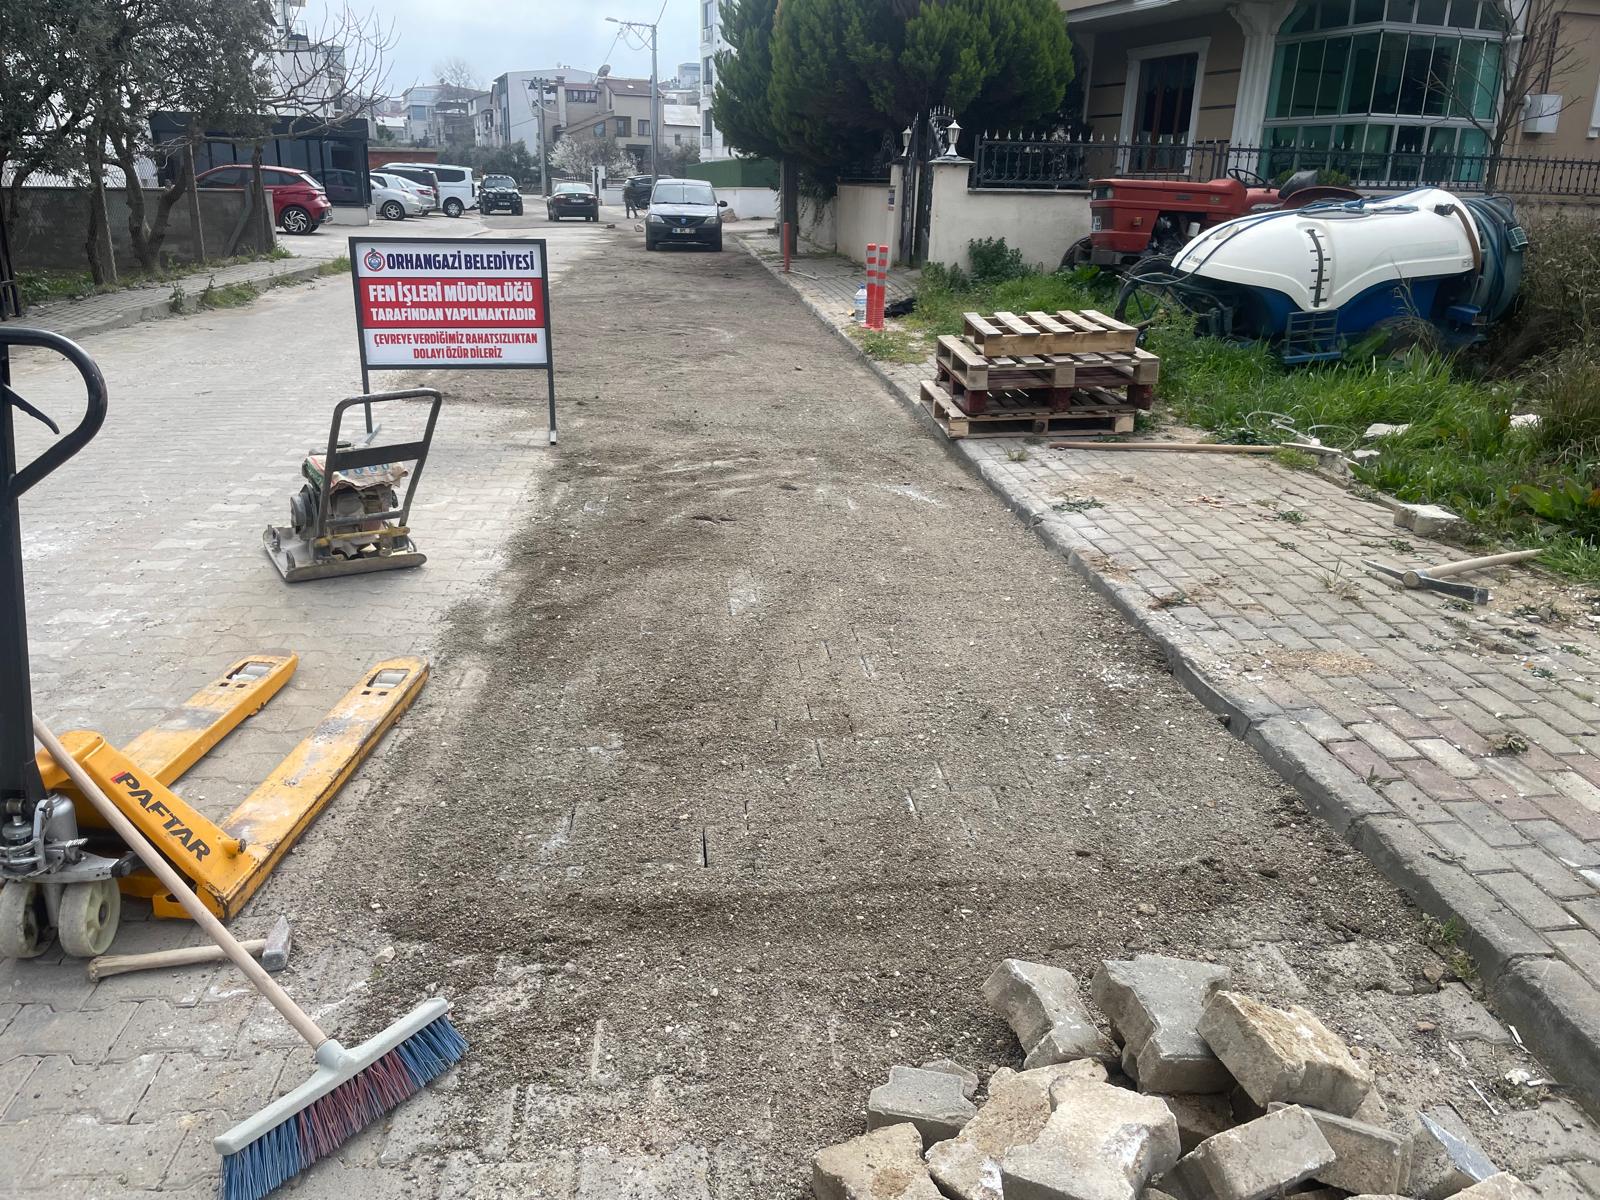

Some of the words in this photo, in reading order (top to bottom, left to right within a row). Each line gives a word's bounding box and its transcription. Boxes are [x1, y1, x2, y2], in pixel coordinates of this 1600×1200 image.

[387, 251, 462, 270] ORHANGAZİ
[465, 251, 535, 270] BELEDİYESİ
[369, 285, 396, 302] FEN
[397, 282, 442, 305] İŞLERİ
[445, 282, 533, 302] MÜDÜRLÜĞÜ
[371, 308, 443, 321] TARAFINDAN
[445, 308, 536, 321] YAPILMAKTADIR
[374, 333, 412, 347] ÇEVREYE
[413, 331, 464, 345] VERDİĞİMİZ
[466, 333, 537, 344] RAHATSIZLIKTAN
[413, 348, 445, 359] DOLAYI
[446, 346, 469, 359] ÖZÜR
[470, 346, 503, 359] DİLERİZ
[112, 772, 211, 862] PAFTAR
